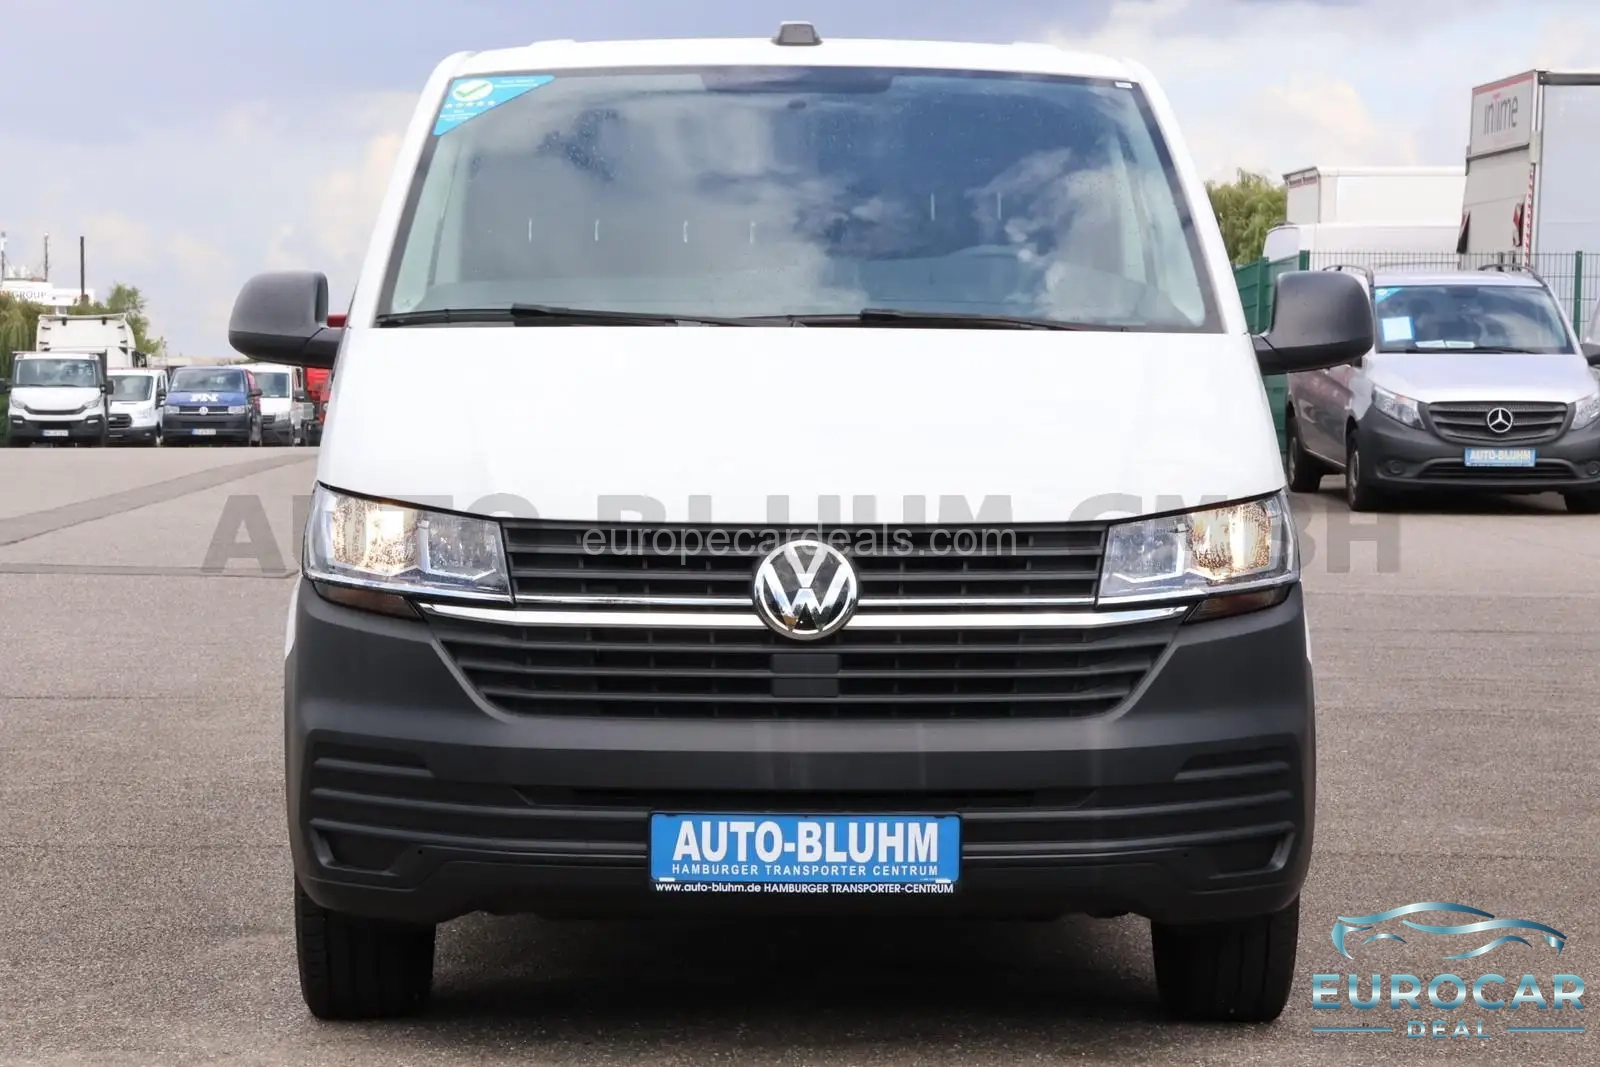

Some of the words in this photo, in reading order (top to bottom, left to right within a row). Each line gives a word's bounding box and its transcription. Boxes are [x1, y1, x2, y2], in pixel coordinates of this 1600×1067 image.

[672, 820, 938, 863] AUTO-BLUHM
[672, 863, 758, 876] HAMBURGER
[765, 864, 867, 876] TRANSPORTER
[873, 865, 938, 876] CENTRUM
[655, 882, 761, 893] www.auto-bluhm.de
[764, 883, 828, 893] HAMBURGER
[831, 883, 954, 894] TRANSPORTER-CENTRUM
